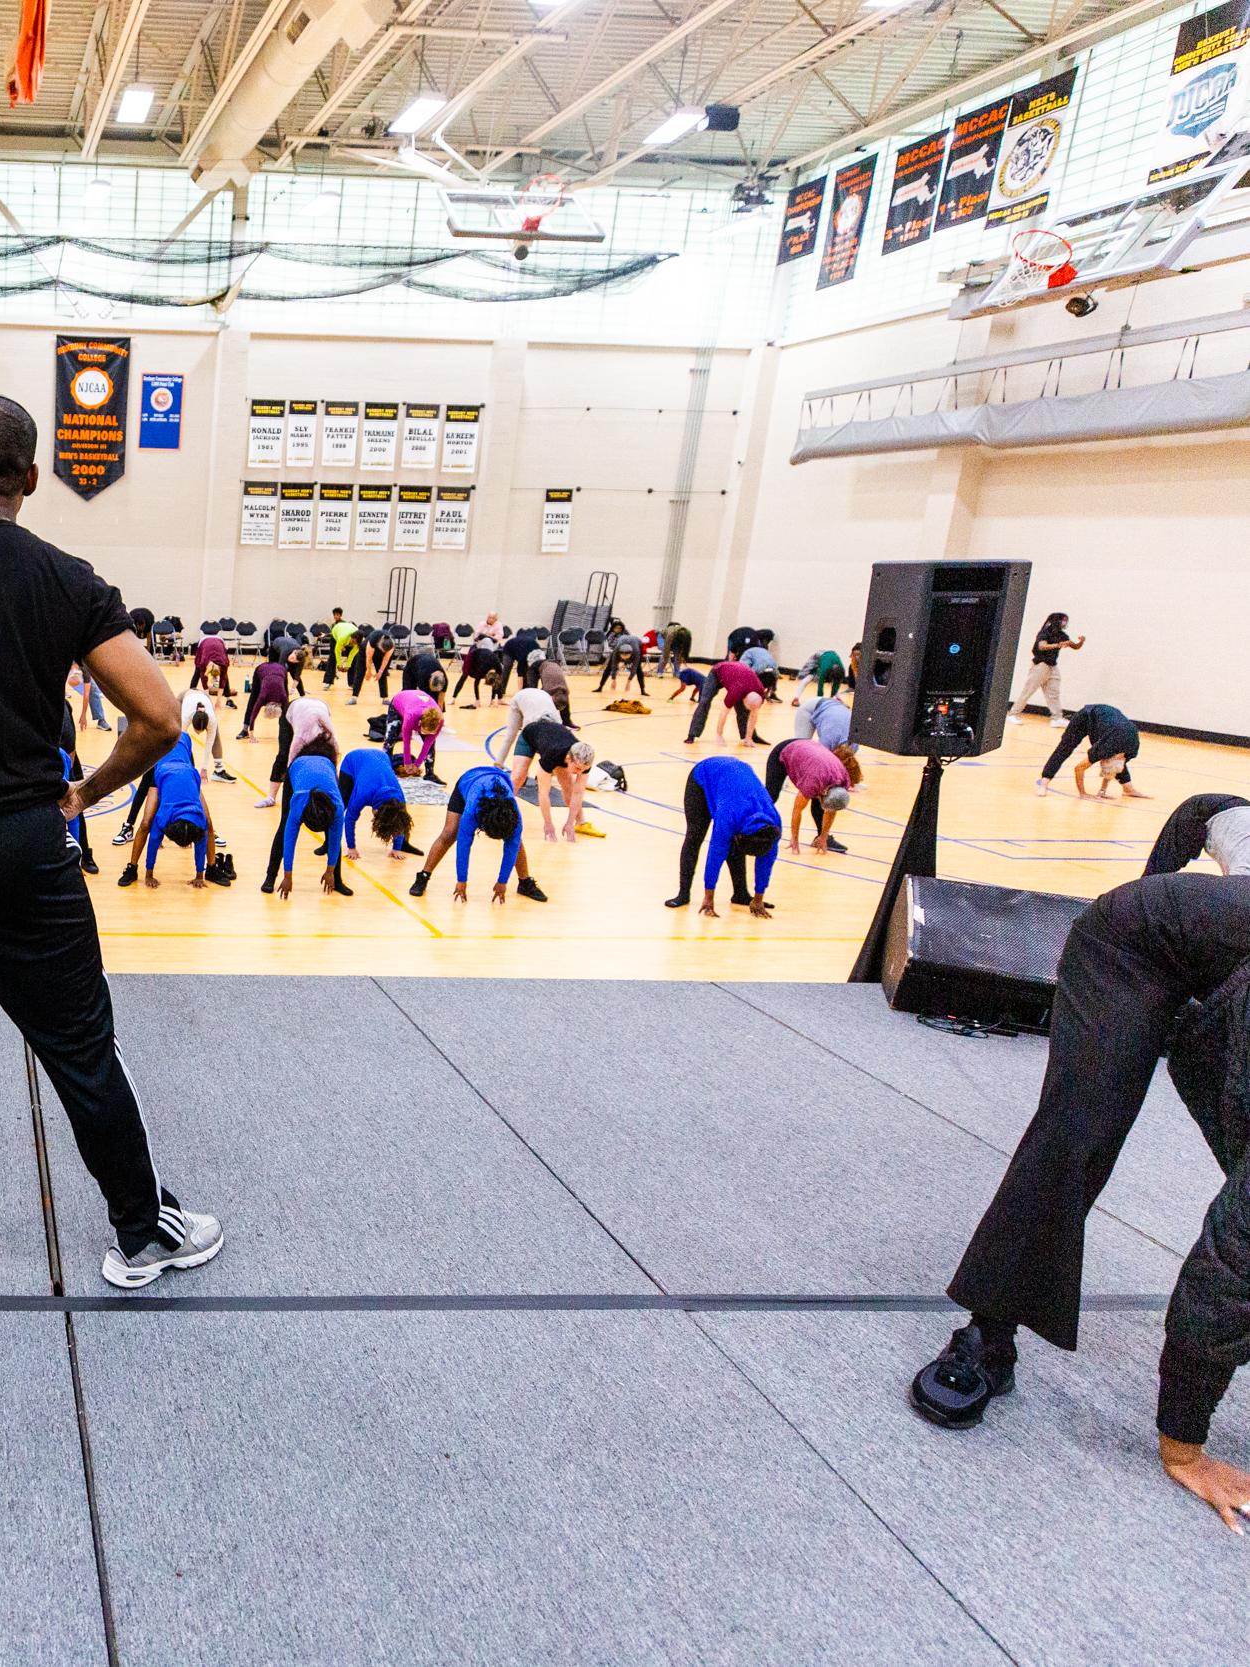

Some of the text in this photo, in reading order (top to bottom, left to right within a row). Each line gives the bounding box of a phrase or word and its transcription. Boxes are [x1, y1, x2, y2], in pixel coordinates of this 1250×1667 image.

[1029, 91, 1057, 110] MEN'S
[1012, 94, 1069, 125] BASKETBALL
[955, 105, 1009, 136] MCCAC
[897, 136, 946, 167] MCCAC
[77, 353, 107, 363] COLLEGE
[77, 382, 107, 393] NJCAA
[63, 413, 119, 427] NATIONAL
[56, 428, 124, 442] CHAMPIONS
[408, 428, 434, 436] BILAL
[79, 452, 119, 461] BASKETBALL
[72, 463, 106, 475] 2000
[244, 504, 276, 512] MALCOLM
[281, 509, 312, 517] SHAROD
[320, 510, 349, 518] PIERRE
[398, 511, 428, 520] JEFFREY
[440, 510, 463, 518] PAUL
